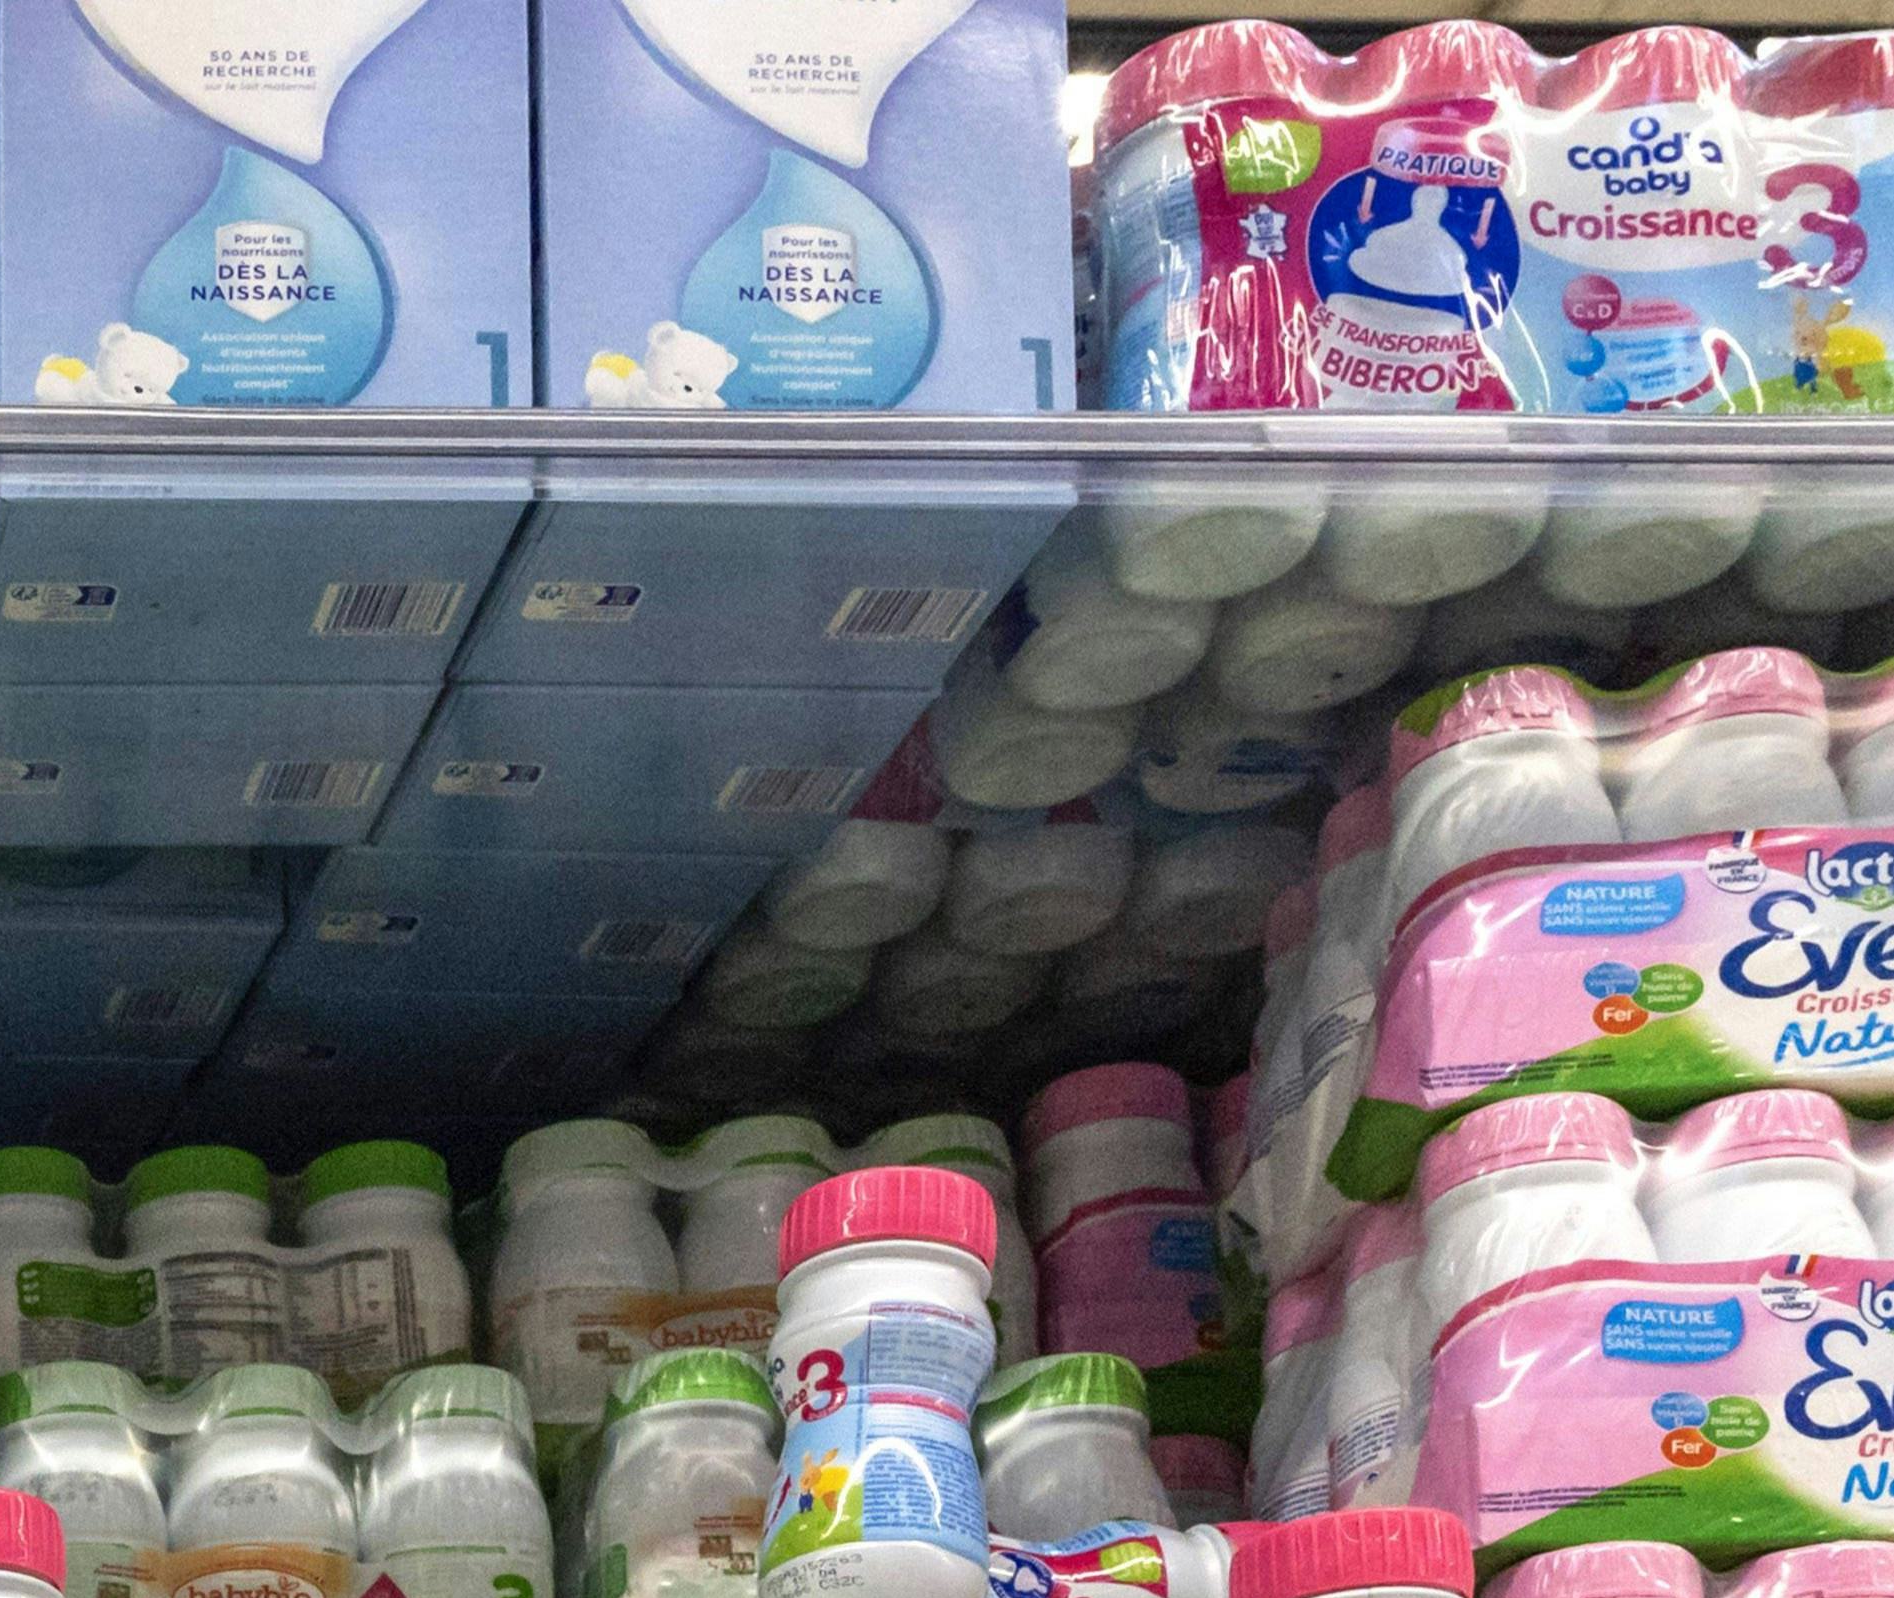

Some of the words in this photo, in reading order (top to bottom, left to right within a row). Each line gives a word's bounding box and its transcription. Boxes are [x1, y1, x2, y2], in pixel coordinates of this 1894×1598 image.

[208, 49, 236, 65] 50
[242, 48, 280, 64] ANS
[286, 49, 312, 65] DE
[201, 64, 319, 80] RECHERCHE
[1377, 146, 1501, 180] PRATIQUE
[1604, 170, 1691, 196] baby
[1529, 200, 1758, 242] Croissance
[1764, 163, 1869, 288] 3
[218, 256, 268, 283] DÈS
[274, 263, 309, 282] LA
[189, 284, 337, 304] NAISSANCE
[1312, 303, 1336, 329] SE
[1335, 318, 1475, 354] TRANSFORME
[1323, 350, 1480, 395] BIBERON
[1565, 885, 1656, 900] NATURE
